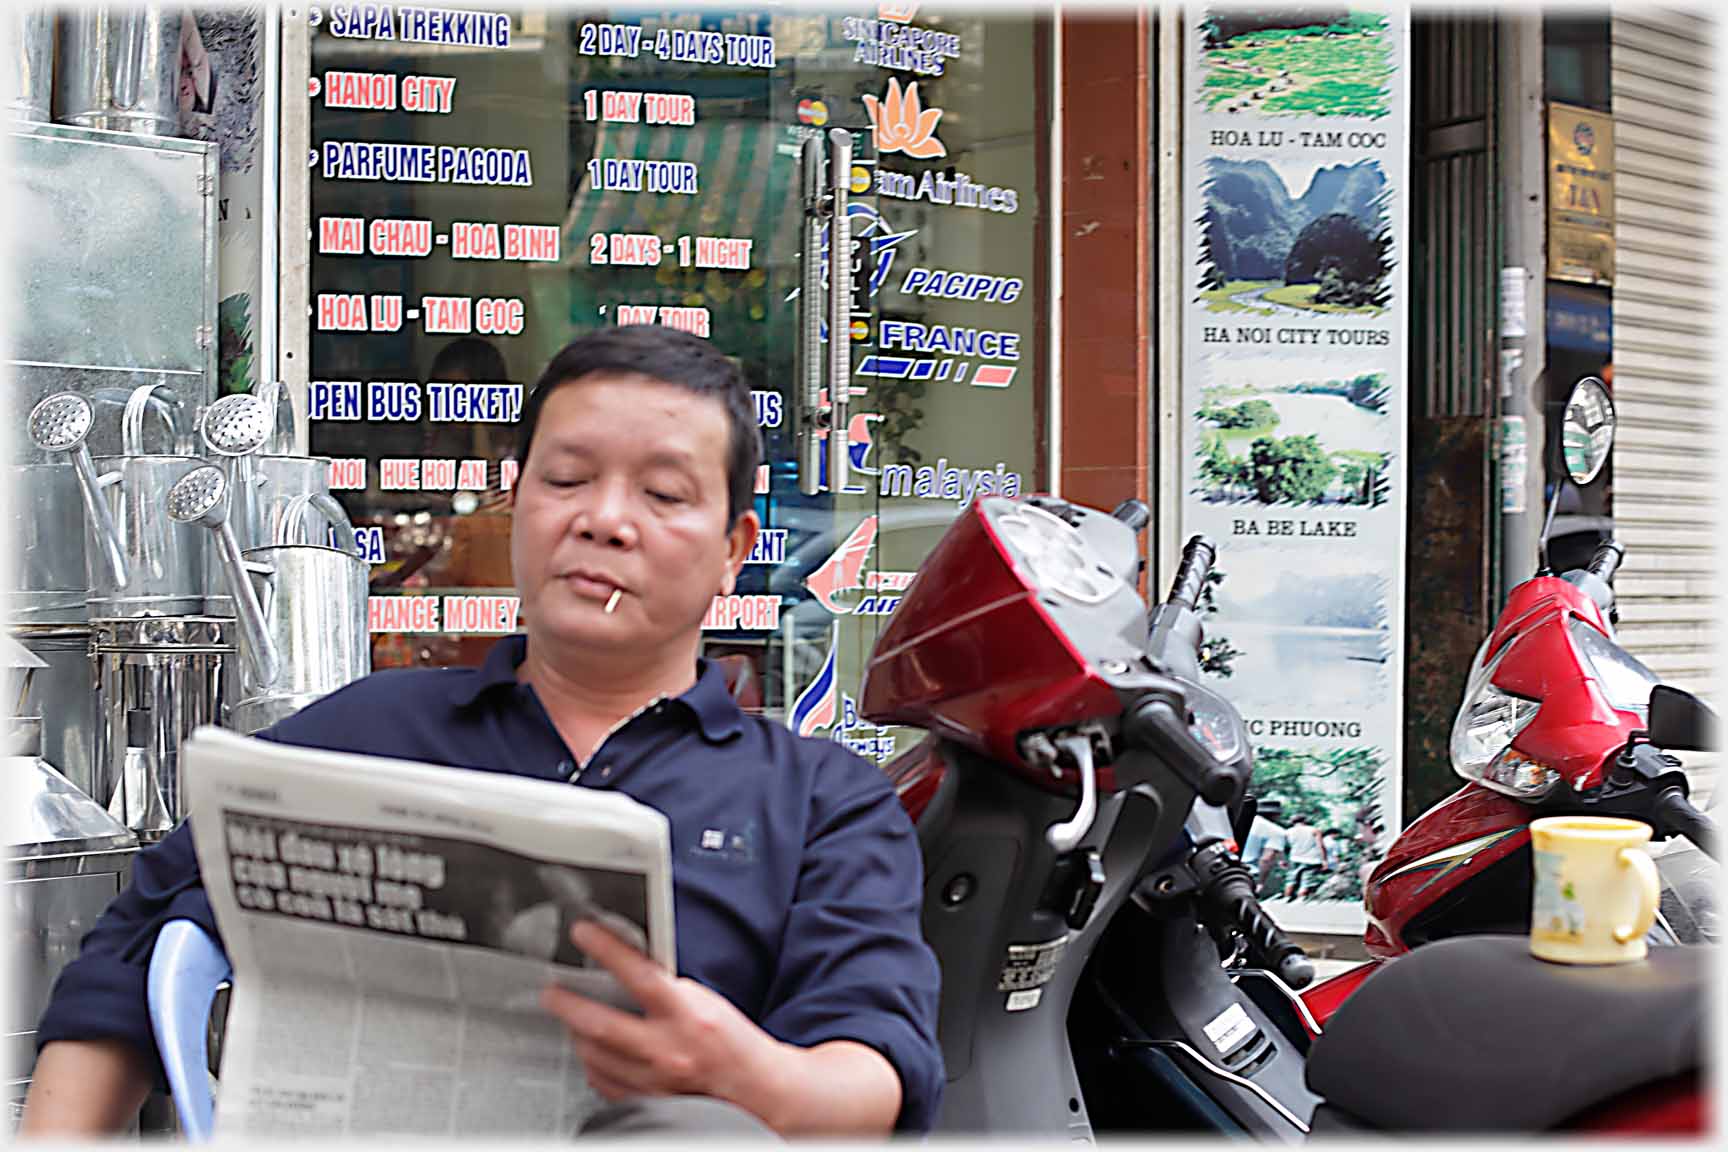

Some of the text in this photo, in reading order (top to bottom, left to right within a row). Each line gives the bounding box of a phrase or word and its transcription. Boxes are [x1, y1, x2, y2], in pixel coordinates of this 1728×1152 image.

[329, 6, 511, 48] SAPA TREKKING
[579, 24, 597, 55] 2
[599, 25, 641, 58] DAY
[654, 29, 671, 60] 4
[671, 31, 725, 64] DAYS
[726, 34, 776, 68] TOUR
[842, 16, 960, 58] SINGAPORE
[853, 38, 945, 76] AIRLINES
[325, 72, 456, 113] HANOI CITY
[584, 90, 696, 125] 1 DAY TOUR
[1210, 131, 1252, 146] HOA
[1258, 132, 1283, 147] LU
[1301, 132, 1343, 147] TAM
[1348, 133, 1386, 149] COC
[323, 142, 532, 187] PARFUME PAGODA
[588, 158, 698, 194] 1 DAY TOUR
[915, 170, 1018, 214] Airlines
[319, 217, 364, 254] MAI
[368, 218, 432, 256] CHAU
[452, 223, 500, 260] HOA
[503, 225, 560, 262] BINH
[591, 233, 609, 265] 2
[609, 234, 661, 267] DAYS
[677, 236, 691, 266] 1
[694, 236, 752, 270] NIGHT
[317, 294, 367, 331] HOA
[370, 295, 403, 332] LU
[422, 297, 471, 333] TAM
[476, 298, 524, 335] COC
[617, 305, 710, 338] DAY TOUR
[880, 320, 1020, 360] FRANCE
[1203, 327, 1390, 345] HA NOI CITY TOURS
[308, 381, 524, 423] PEN BUS TICKET!
[750, 390, 782, 428] US
[327, 458, 366, 490] NOI
[380, 459, 420, 490] HUE
[421, 459, 456, 490] HOI
[457, 459, 487, 490] AN
[880, 459, 1021, 509] malaysia
[742, 529, 786, 564] ENT
[1233, 520, 1357, 537] BA BE LAKE
[368, 596, 520, 633] HANGE MONEY
[701, 595, 782, 630] IRPORT
[1269, 720, 1361, 738] PHUONG
